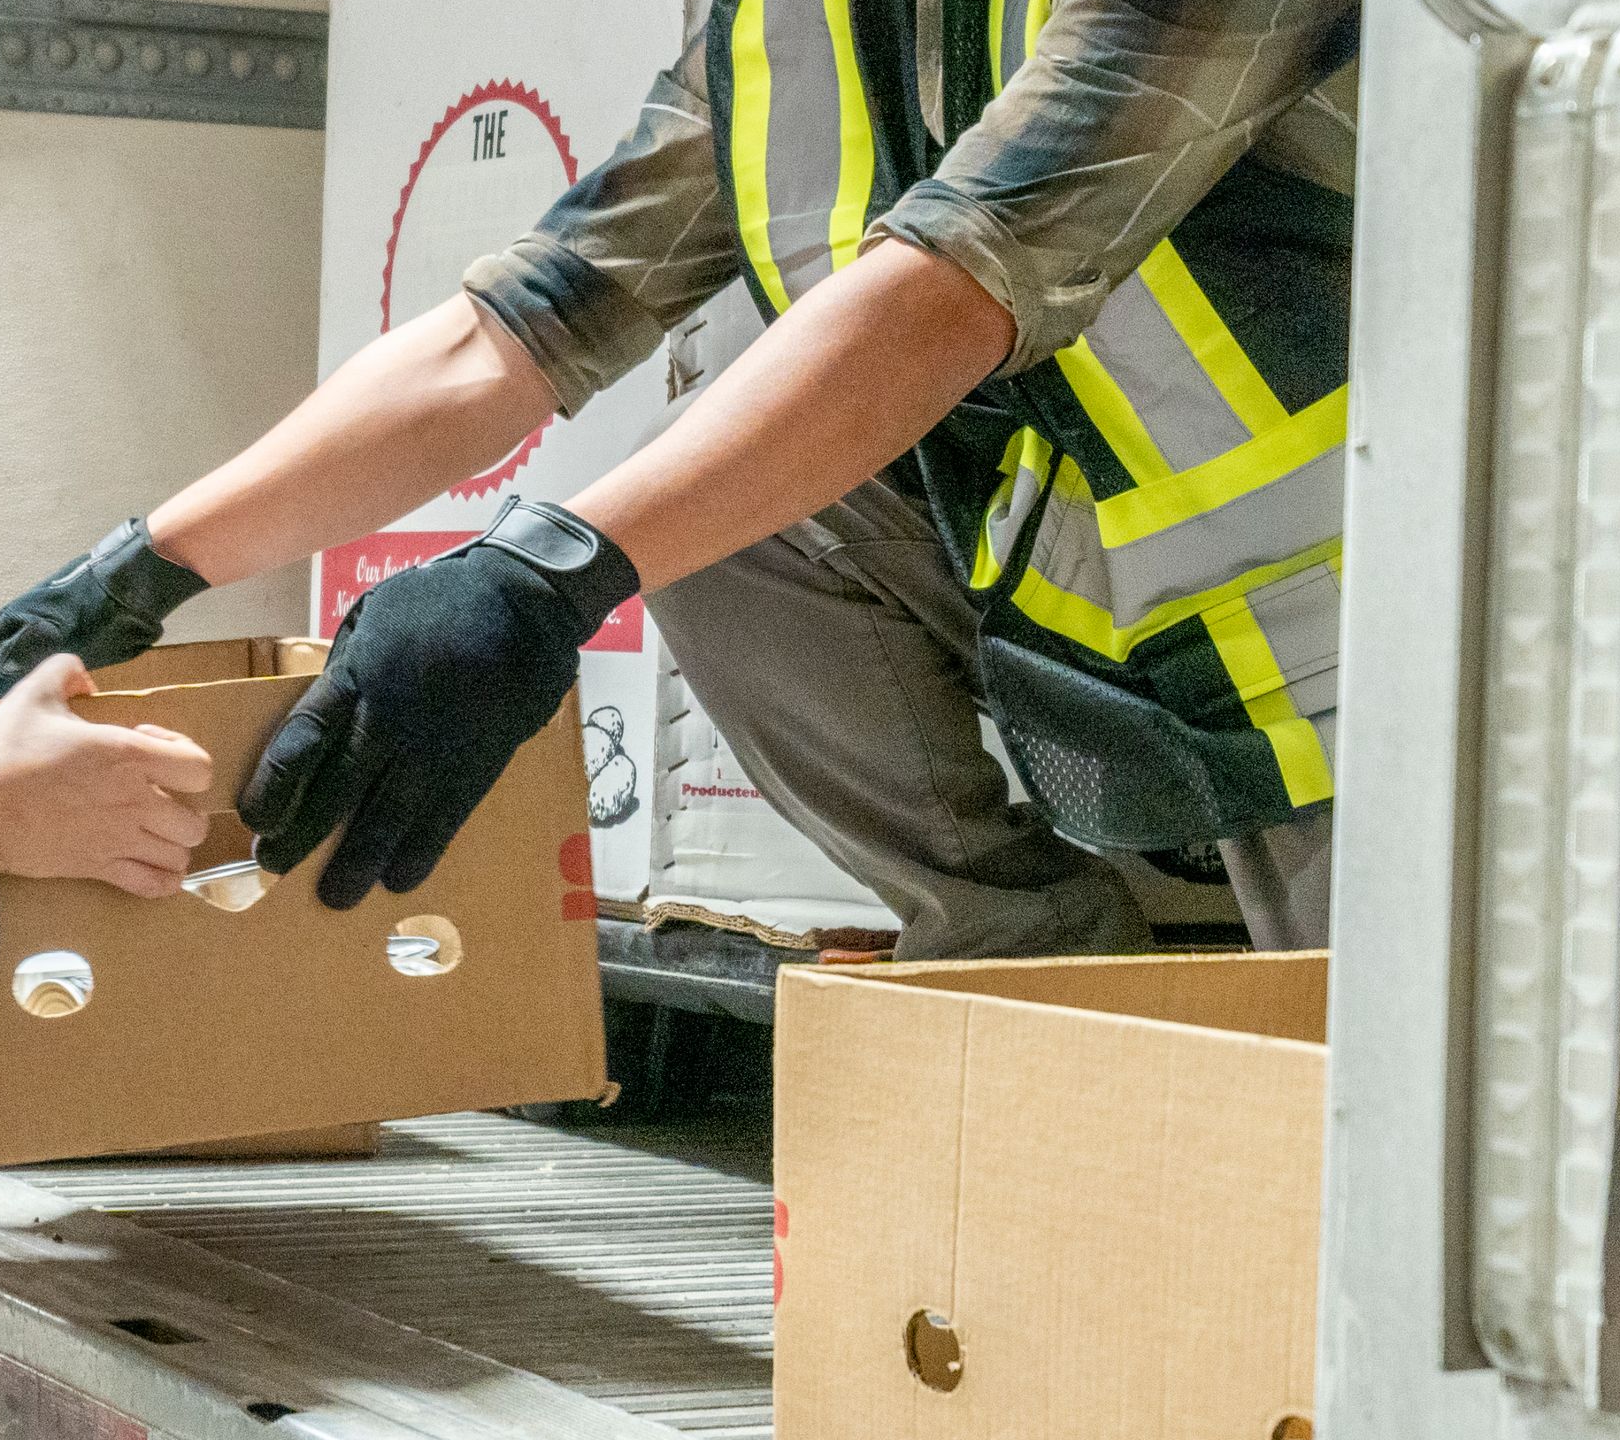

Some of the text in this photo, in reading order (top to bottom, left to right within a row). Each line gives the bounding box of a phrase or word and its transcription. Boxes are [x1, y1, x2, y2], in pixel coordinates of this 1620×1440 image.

[473, 110, 508, 161] THE
[356, 555, 380, 582] Our
[681, 783, 765, 800] Producteu
